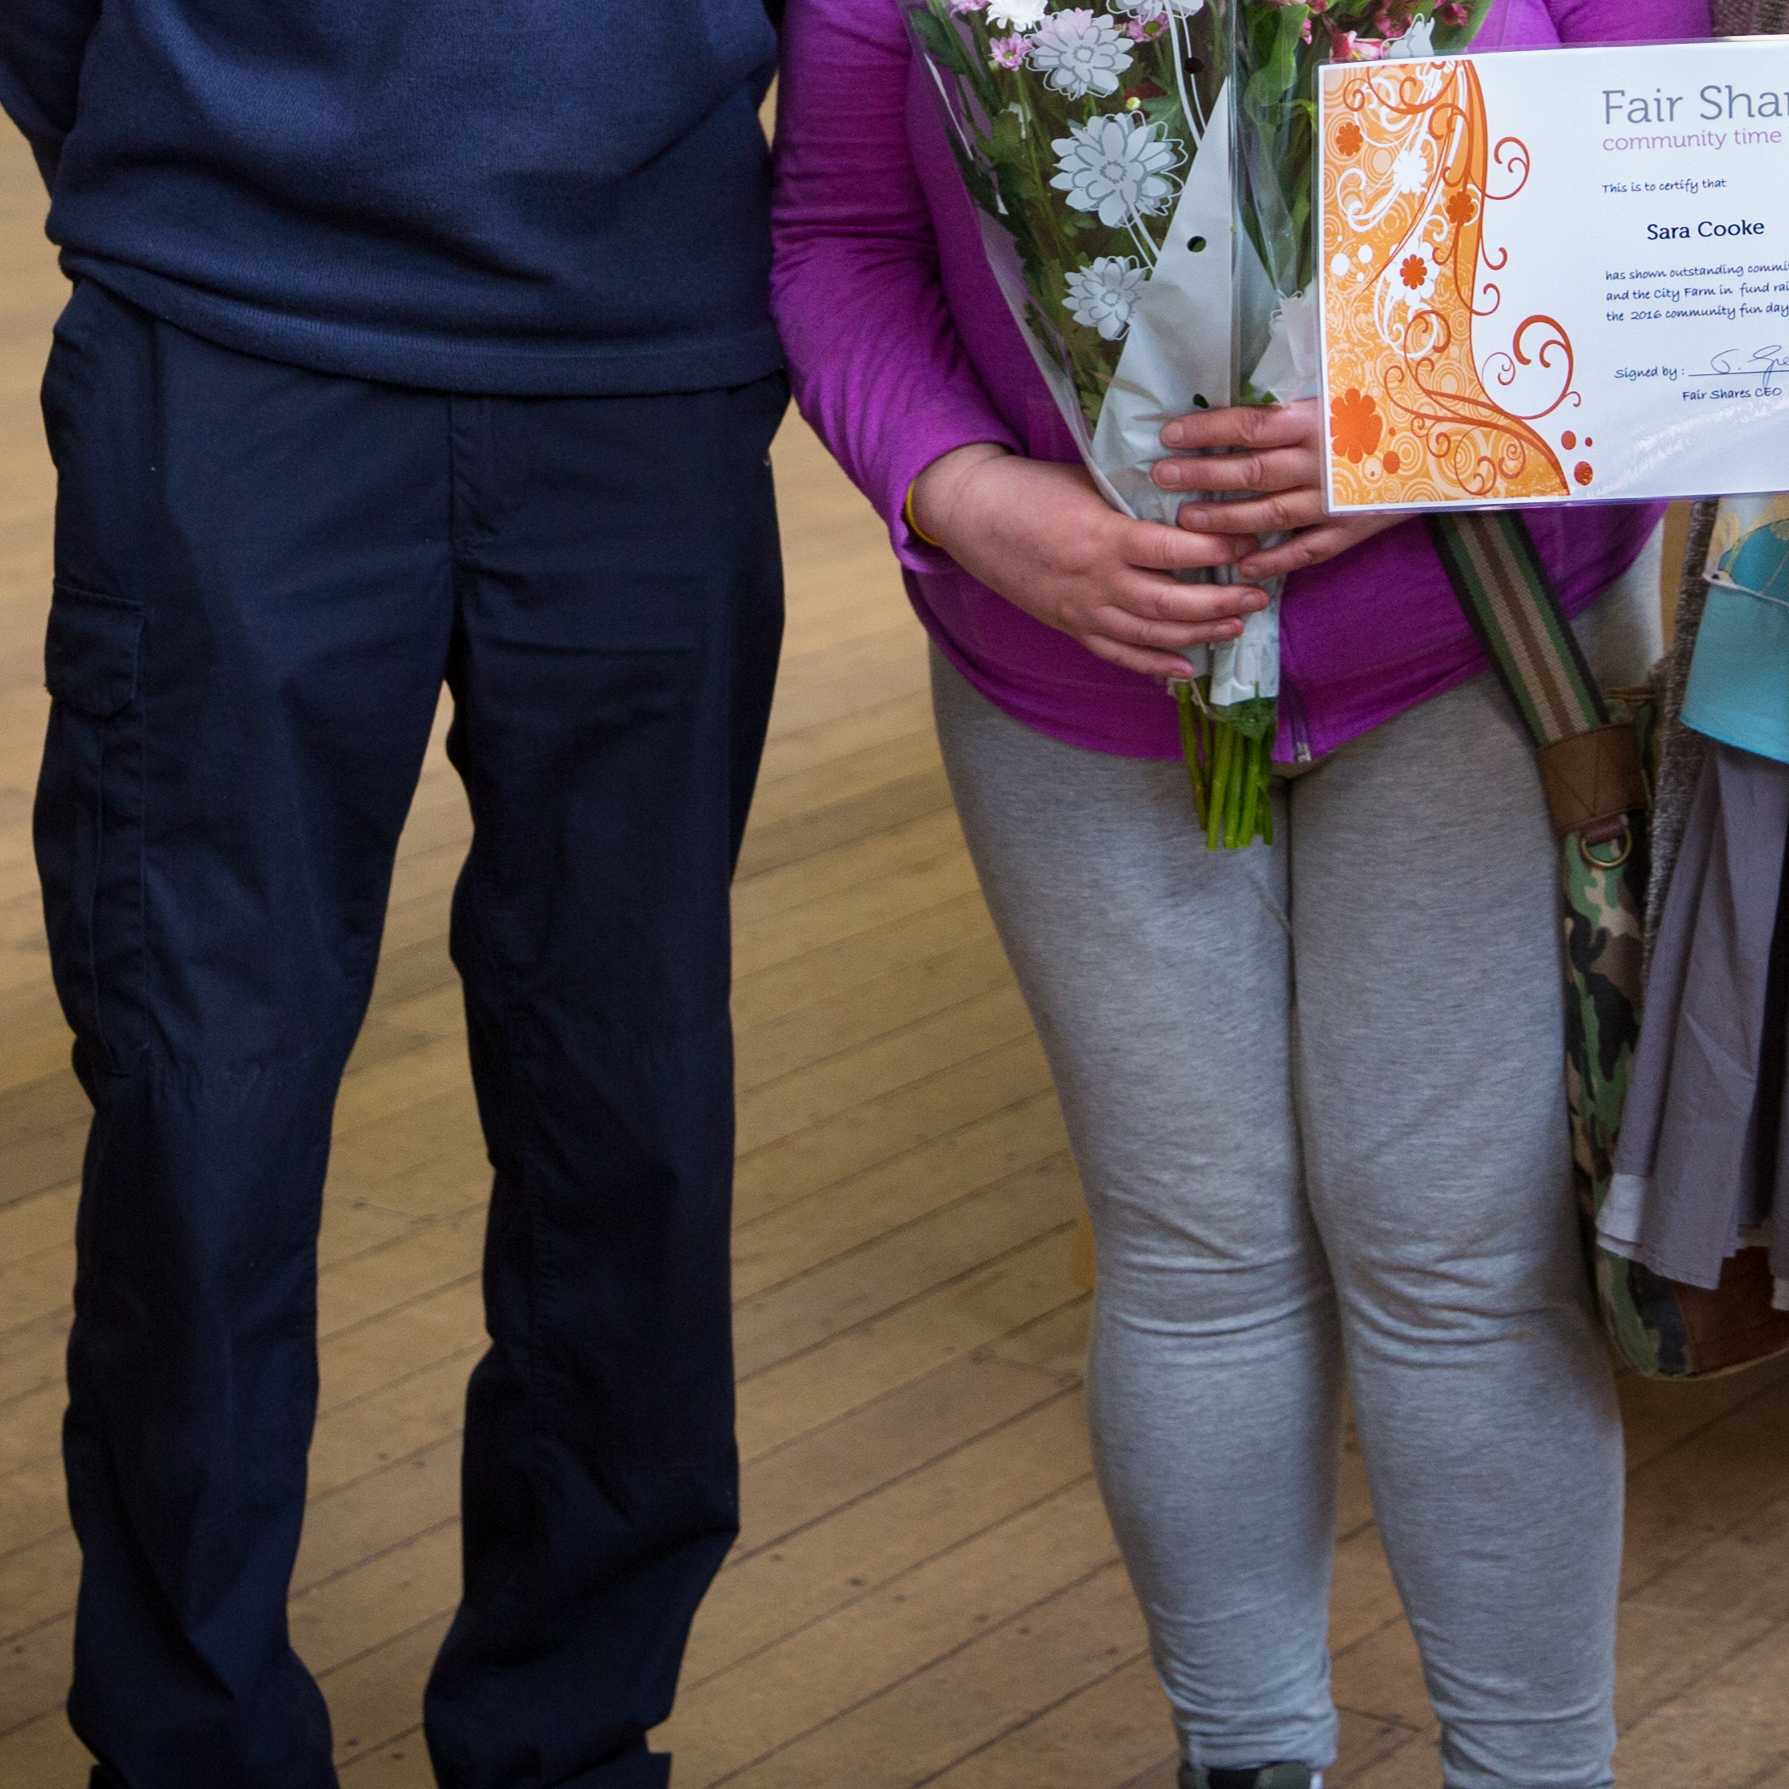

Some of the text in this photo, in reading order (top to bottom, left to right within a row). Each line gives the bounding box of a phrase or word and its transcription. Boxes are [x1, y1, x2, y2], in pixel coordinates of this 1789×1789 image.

[1602, 88, 1683, 124] Fair
[1602, 129, 1727, 151] community
[1734, 128, 1782, 145] time
[1602, 178, 1727, 194] This is to certify that
[1647, 219, 1765, 240] Sara Cooke
[1605, 270, 1626, 280] has
[1629, 269, 1667, 279] shown
[1669, 264, 1744, 277] outstanding
[1606, 290, 1629, 301] and
[1632, 289, 1650, 299] the
[1653, 287, 1680, 302] City
[1684, 287, 1715, 297] Farm
[1719, 284, 1733, 295] in
[1739, 282, 1770, 297] fund
[1606, 302, 1789, 321] the 2016 community fun day
[1614, 366, 1659, 381] Signed
[1682, 386, 1782, 401] Fair Shares CEO
